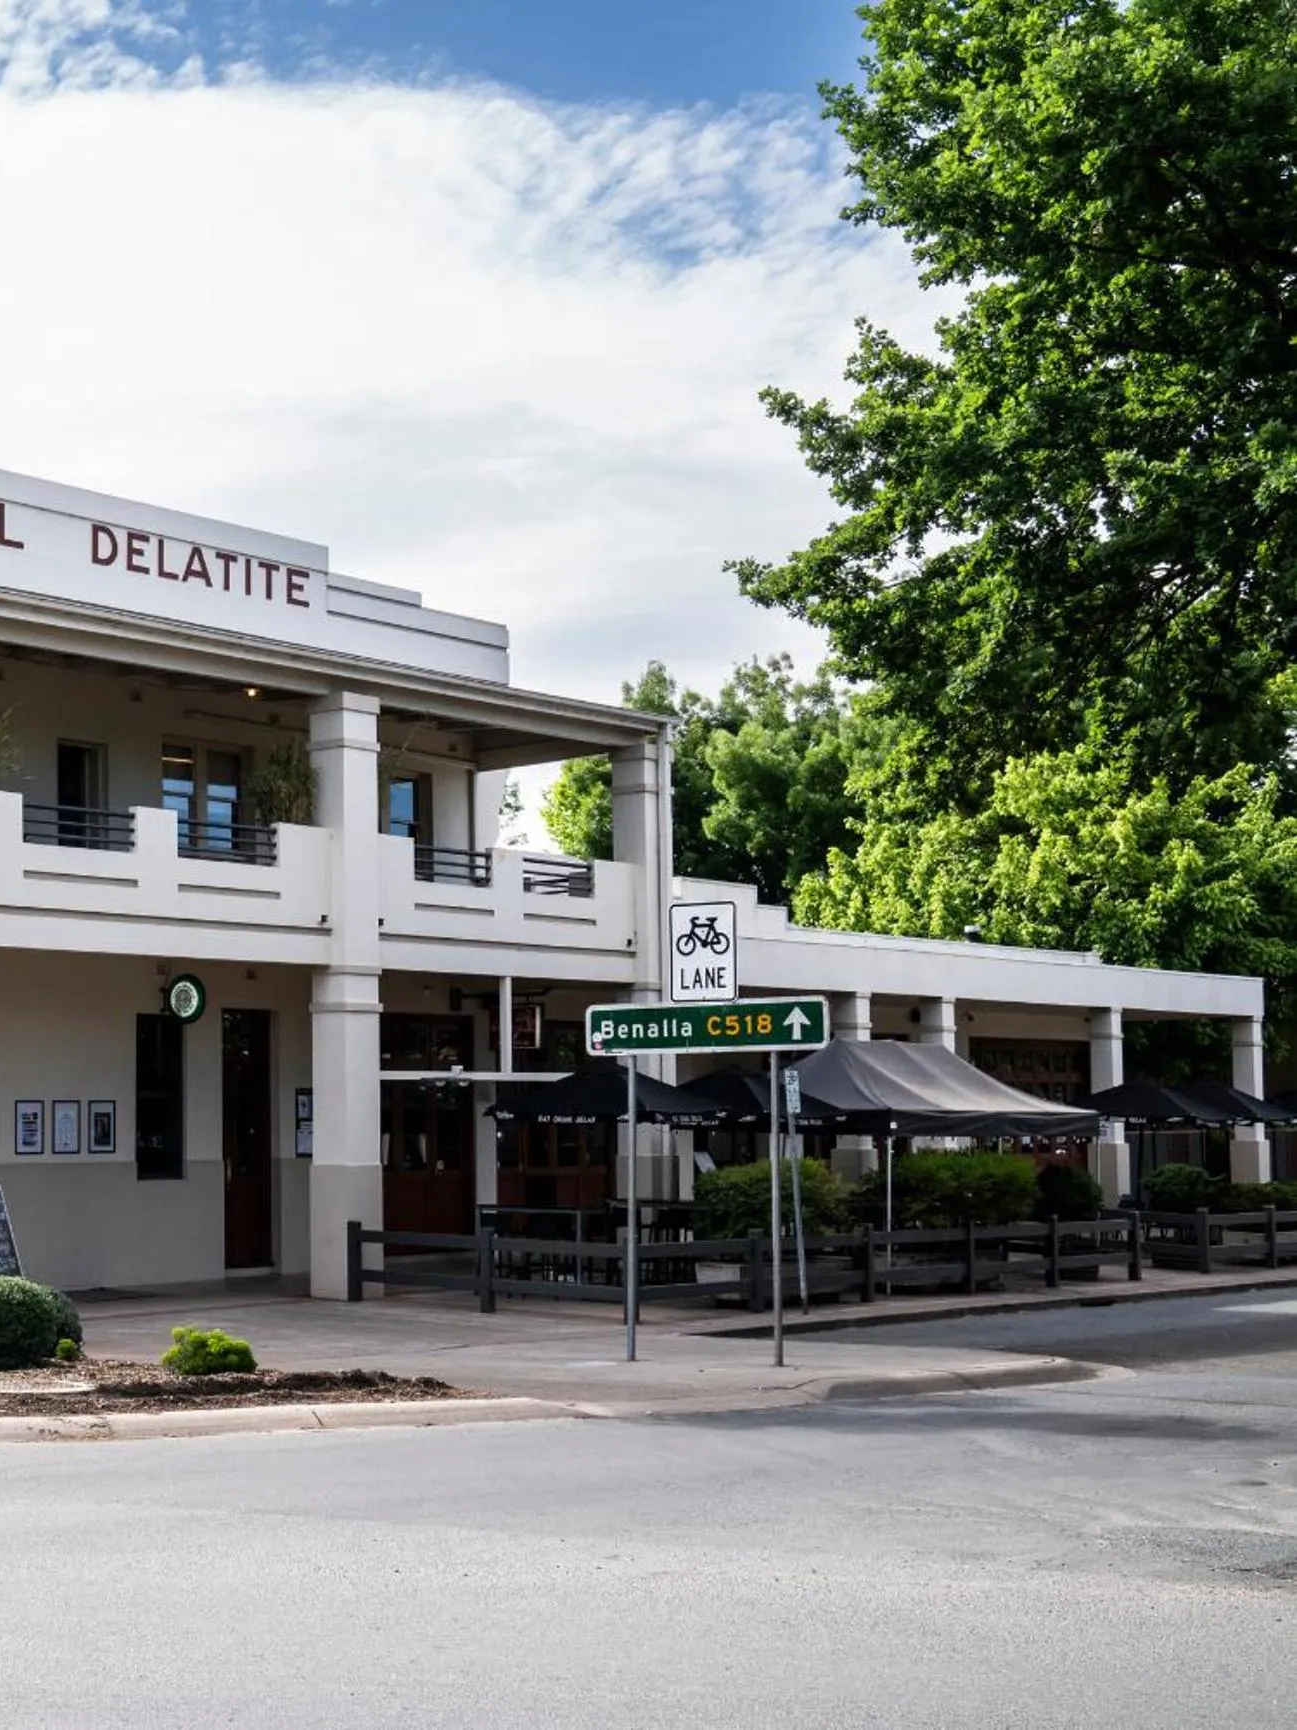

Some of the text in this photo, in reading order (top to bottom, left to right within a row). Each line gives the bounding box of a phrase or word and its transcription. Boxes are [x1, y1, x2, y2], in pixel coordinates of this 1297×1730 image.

[91, 523, 310, 608] DELATITE
[680, 967, 726, 990] LANE
[601, 1013, 772, 1039] Benalla C518
